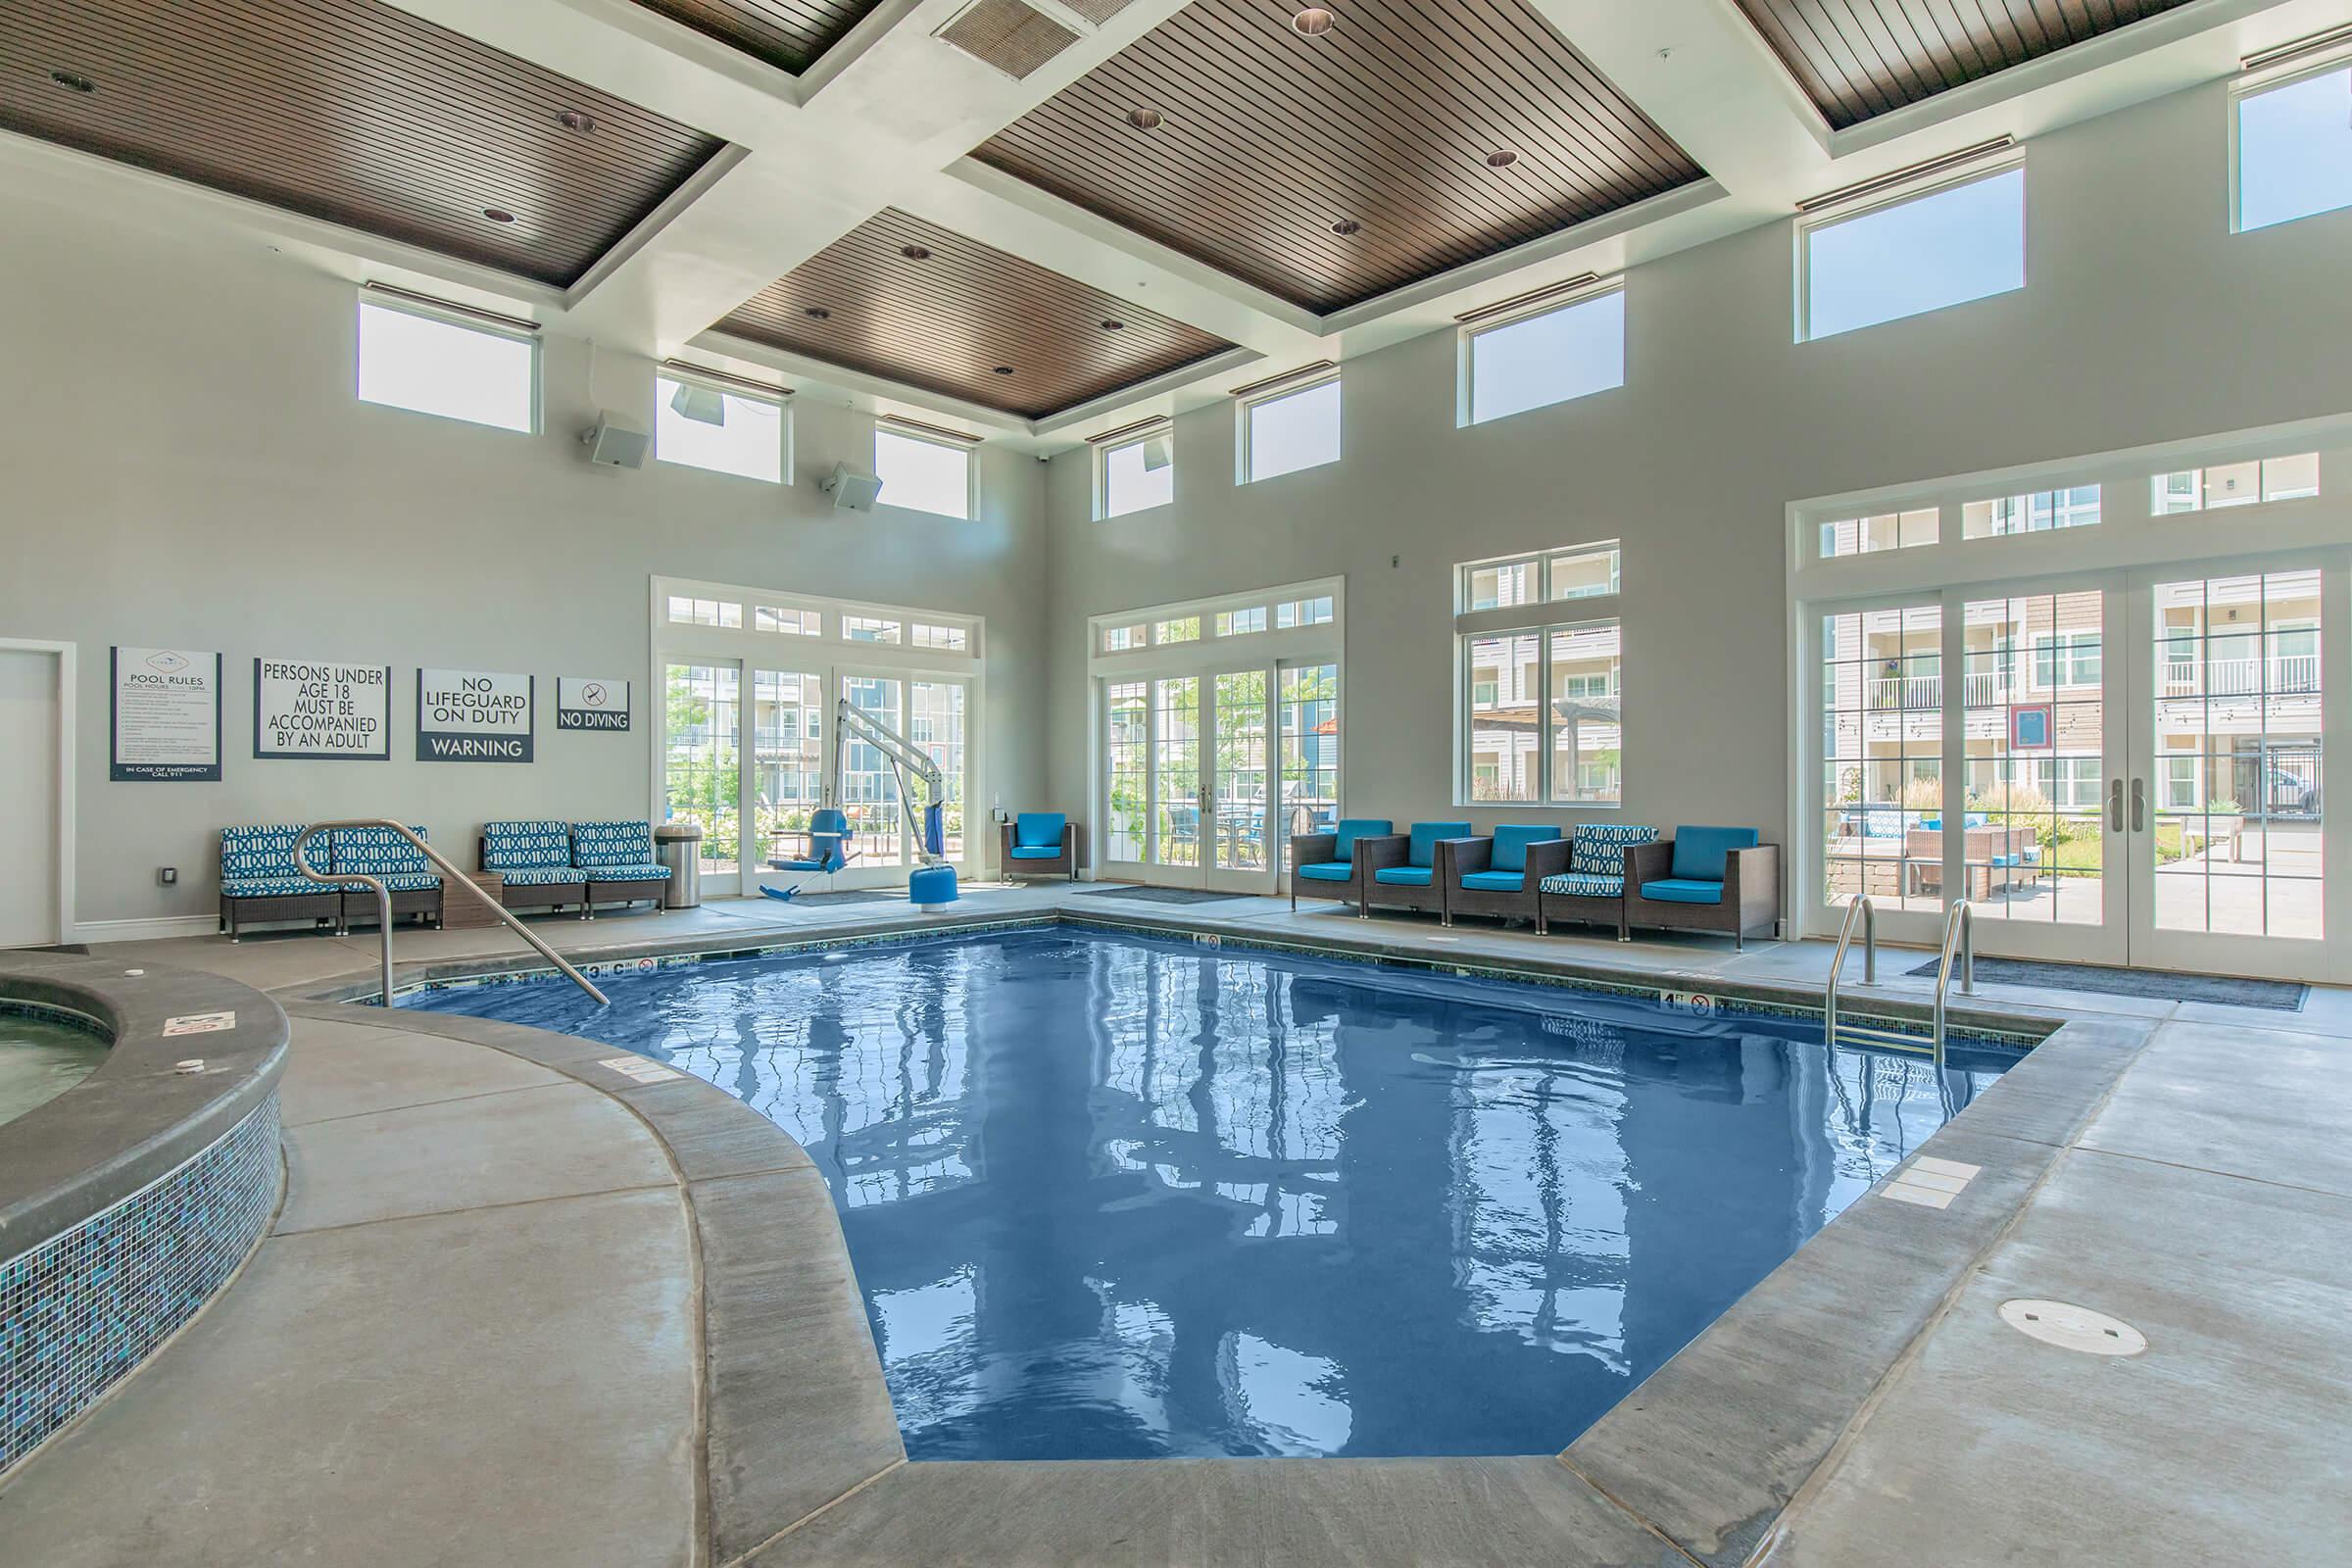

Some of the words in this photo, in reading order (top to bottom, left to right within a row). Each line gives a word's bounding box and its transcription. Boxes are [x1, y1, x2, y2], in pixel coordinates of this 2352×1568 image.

[130, 673, 165, 684] POOL
[169, 676, 204, 686] RULES
[264, 663, 330, 682] PERSONS
[335, 667, 383, 685] UNDER
[298, 683, 328, 699] AGE
[334, 684, 350, 700] 18
[462, 677, 493, 692] NO
[294, 699, 334, 714] MUST
[339, 701, 354, 715] BE
[426, 691, 526, 710] LIFEGUARD
[269, 714, 377, 732] ACCOMPANIED
[433, 708, 465, 722] ON
[472, 710, 519, 724] DUTY
[561, 711, 582, 727] NO
[585, 712, 628, 728] DIVING
[277, 731, 294, 746] BY
[299, 733, 320, 748] AN
[325, 733, 370, 749] ADULT
[431, 738, 523, 757] WARNING
